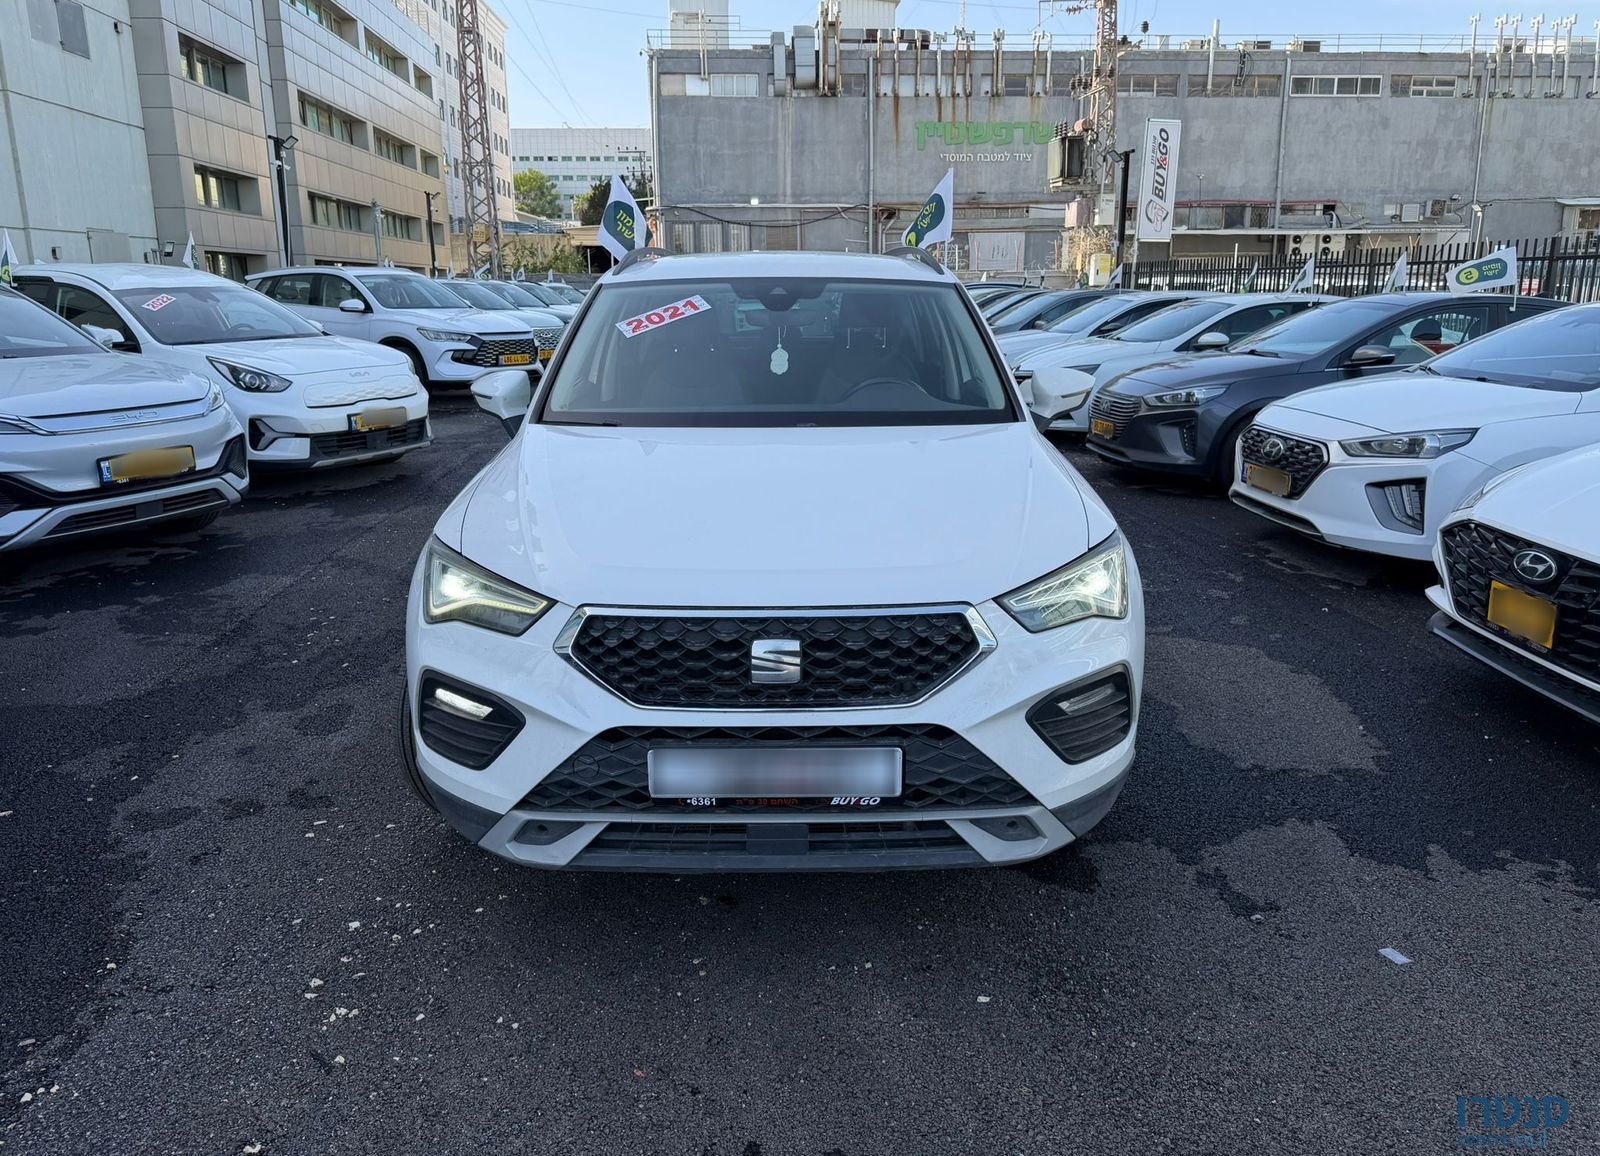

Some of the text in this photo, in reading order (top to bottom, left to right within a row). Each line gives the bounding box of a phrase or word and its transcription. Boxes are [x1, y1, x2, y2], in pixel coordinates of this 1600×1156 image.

[940, 151, 1032, 162] ציוד למטבח המוסדי
[1153, 128, 1169, 201] BUY&GO
[616, 209, 635, 227] מון
[616, 221, 635, 238] שיר
[625, 299, 700, 334] 2021
